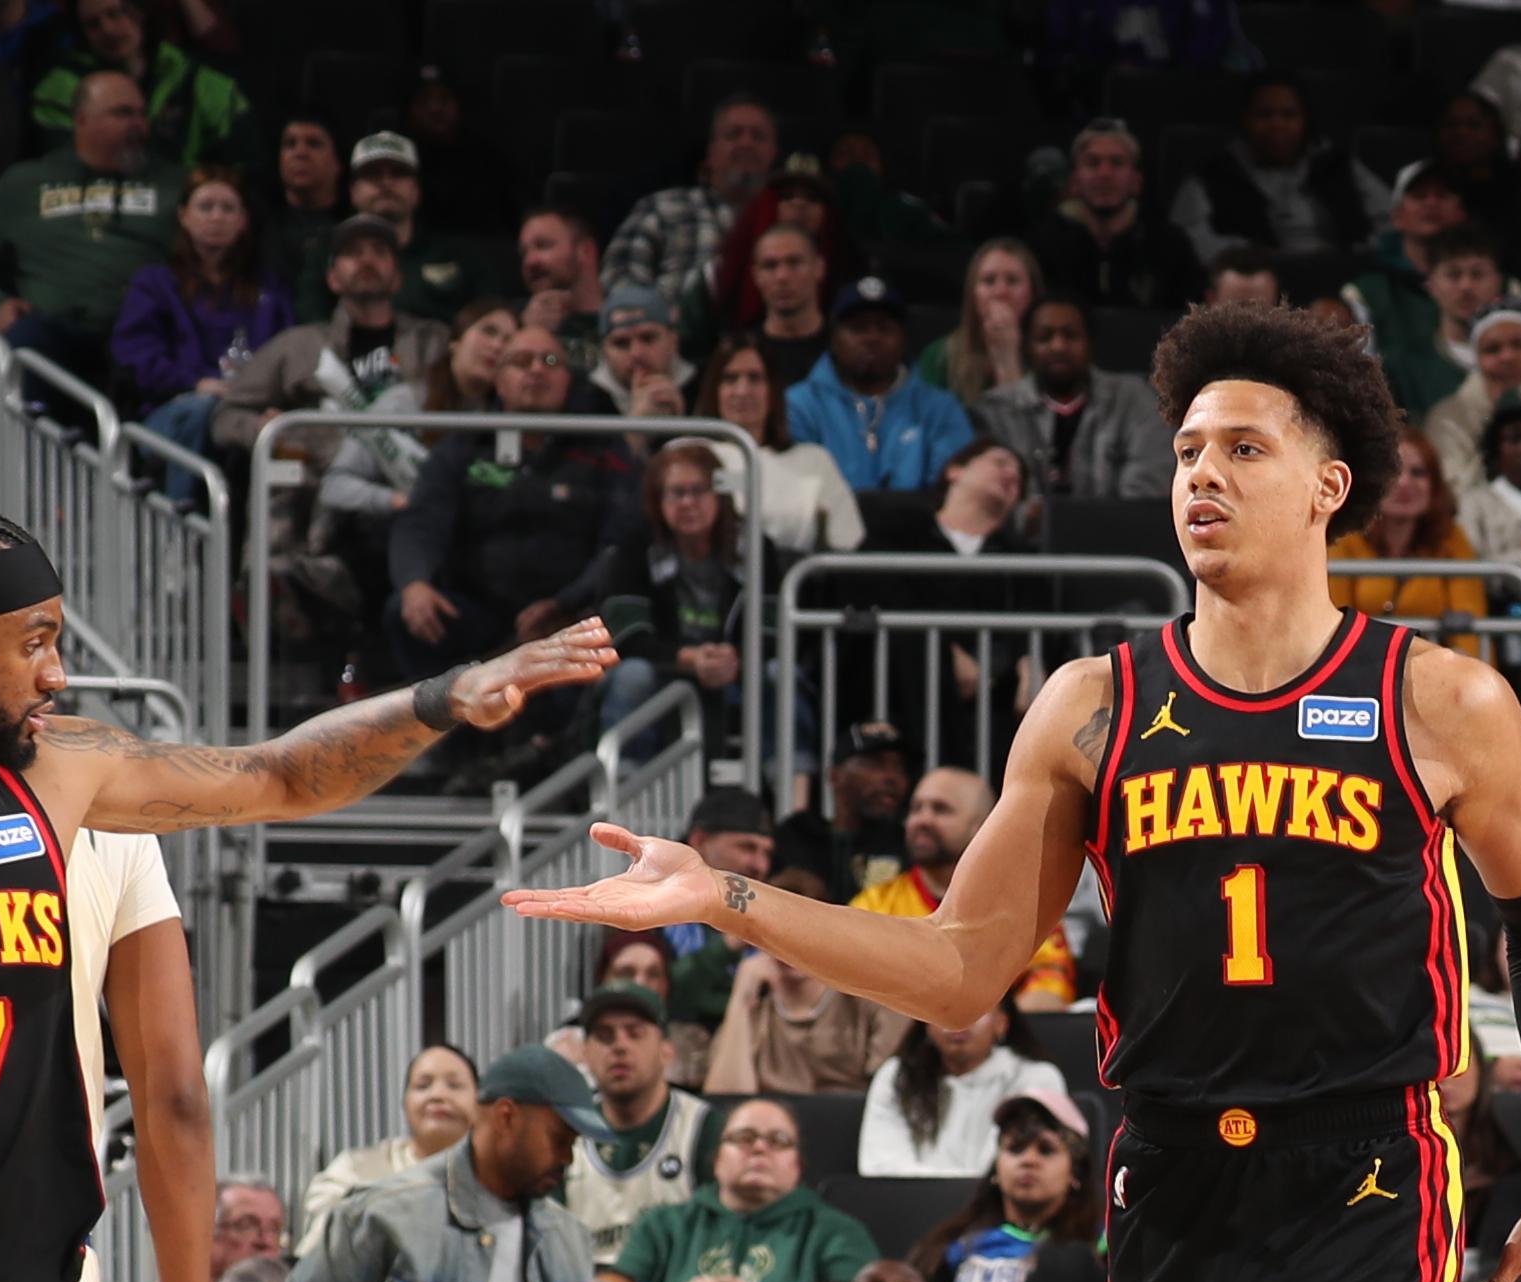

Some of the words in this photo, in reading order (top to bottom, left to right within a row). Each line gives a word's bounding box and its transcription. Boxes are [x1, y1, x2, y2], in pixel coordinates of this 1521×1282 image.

[1306, 706, 1371, 728] paze
[1121, 761, 1383, 856] HAWKS
[1220, 863, 1274, 986] 1
[1223, 1120, 1252, 1136] ATL
